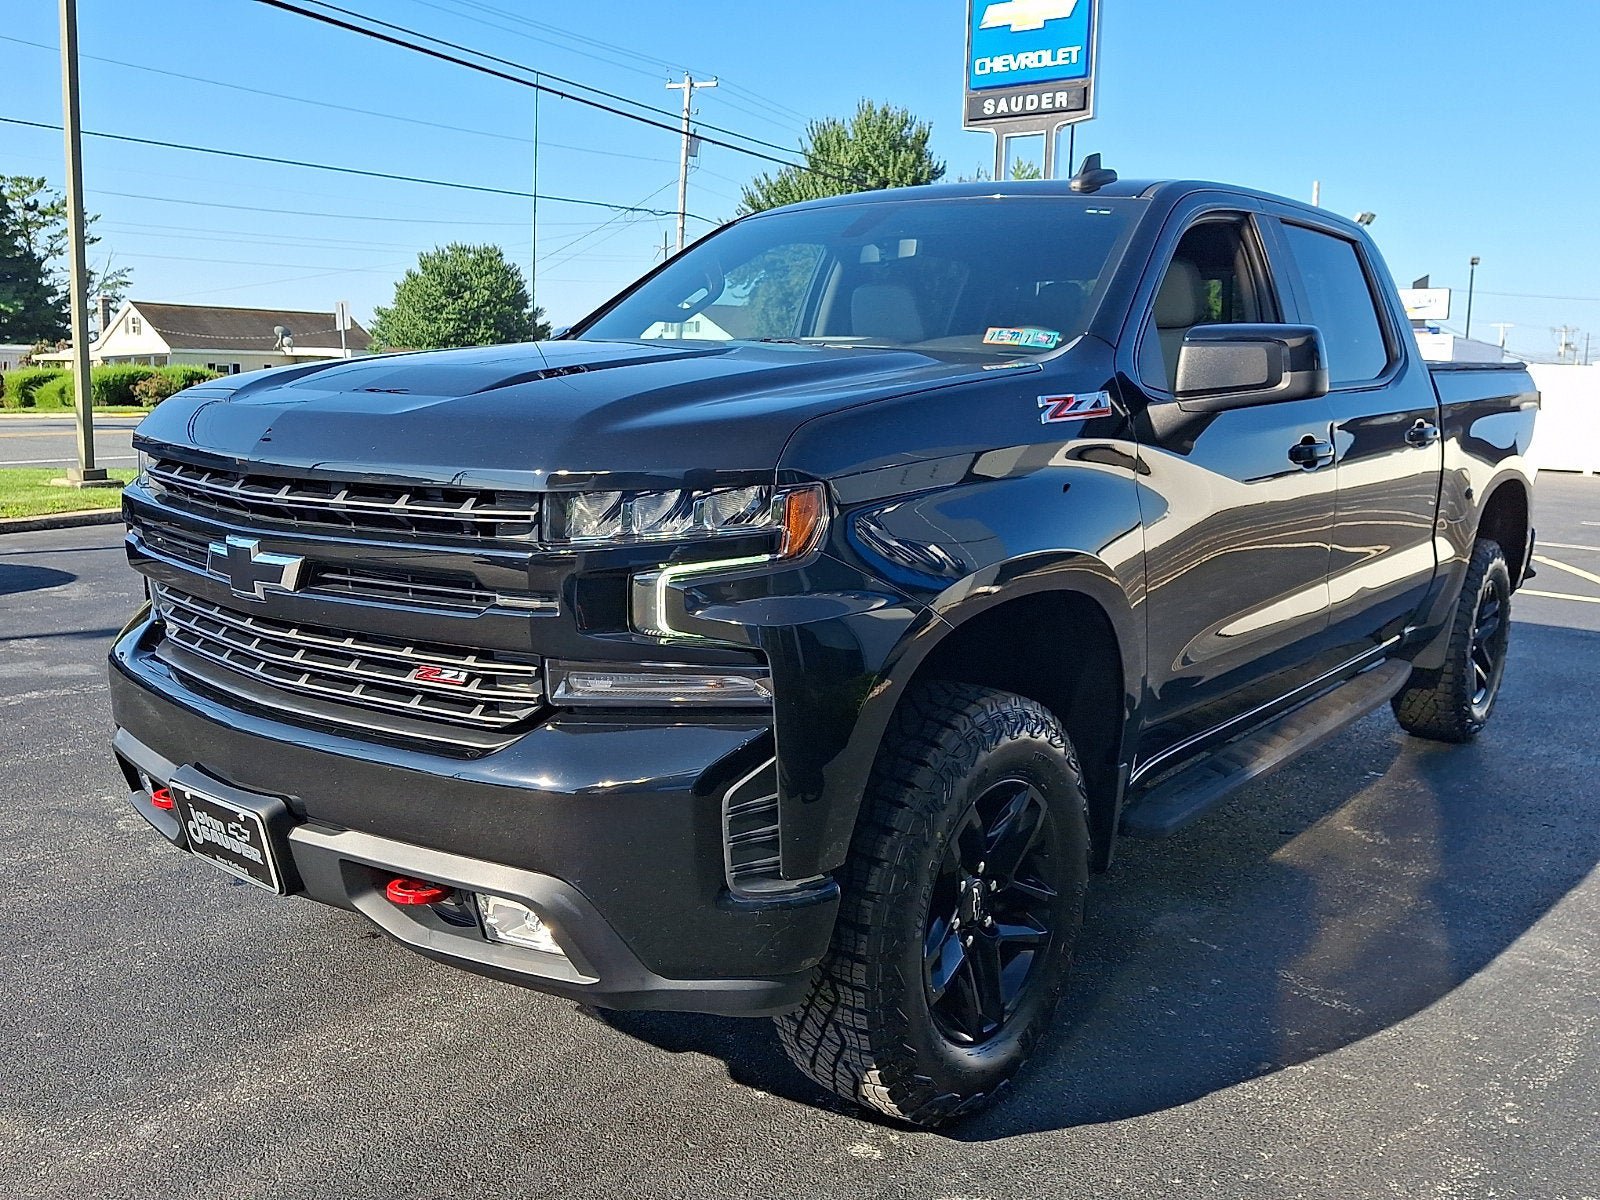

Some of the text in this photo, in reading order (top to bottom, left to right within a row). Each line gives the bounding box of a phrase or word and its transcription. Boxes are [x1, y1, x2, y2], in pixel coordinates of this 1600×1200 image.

[974, 45, 1082, 75] CHEVROLET
[983, 91, 1068, 115] SAUDER
[1037, 391, 1112, 424] Z71
[416, 665, 468, 685] Z71
[200, 824, 264, 865] SAUDER
